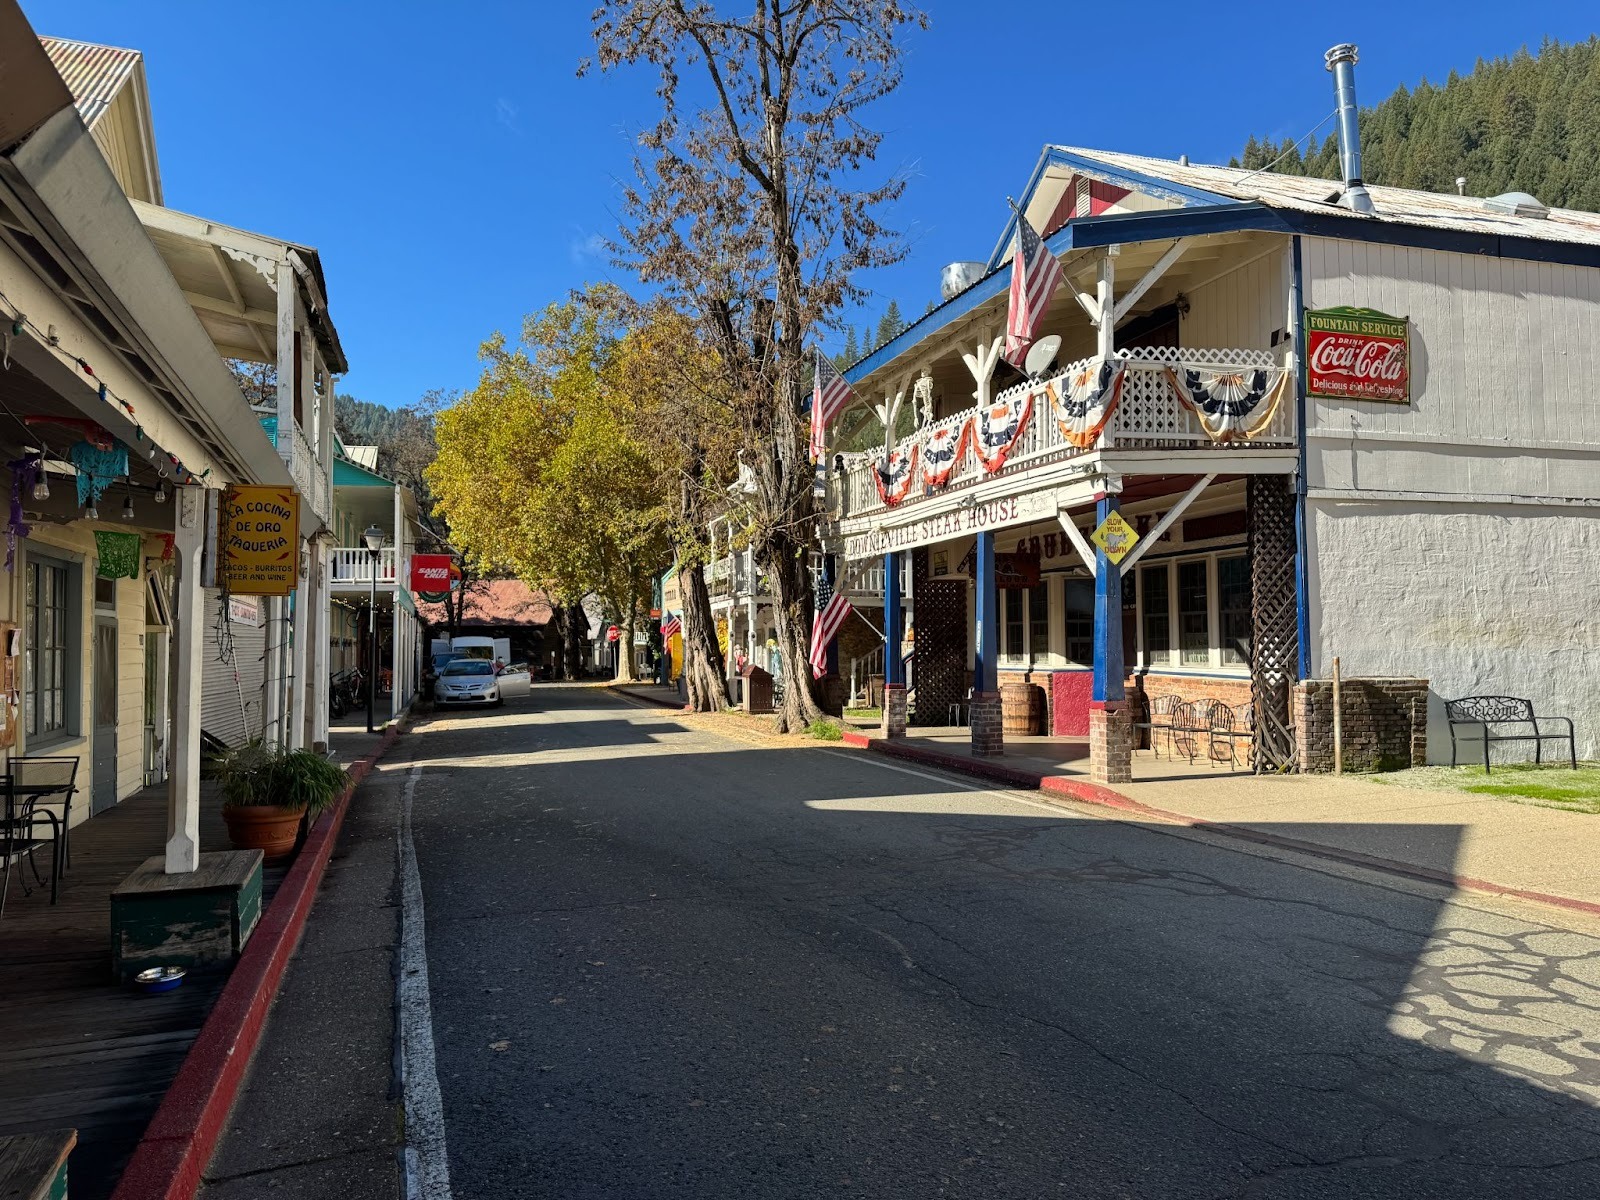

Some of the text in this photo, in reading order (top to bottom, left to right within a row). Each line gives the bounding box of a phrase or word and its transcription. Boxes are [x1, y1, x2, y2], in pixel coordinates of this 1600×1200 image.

[1310, 316, 1405, 336] FOUNTAIN SERVICE
[1337, 337, 1364, 346] DRINK
[1311, 336, 1403, 380] Coca-Cola
[1312, 377, 1348, 390] Delicious
[246, 502, 291, 520] COCINA
[921, 513, 962, 541] STEAK
[966, 496, 1020, 530] HOUSE
[1106, 518, 1123, 526] SLOW
[236, 521, 281, 533] DE ORO
[228, 535, 288, 552] TAQUERIA
[1104, 546, 1127, 554] DOWN
[255, 564, 292, 572] BURRITOS
[228, 573, 248, 581] BEER
[249, 573, 266, 581] AND
